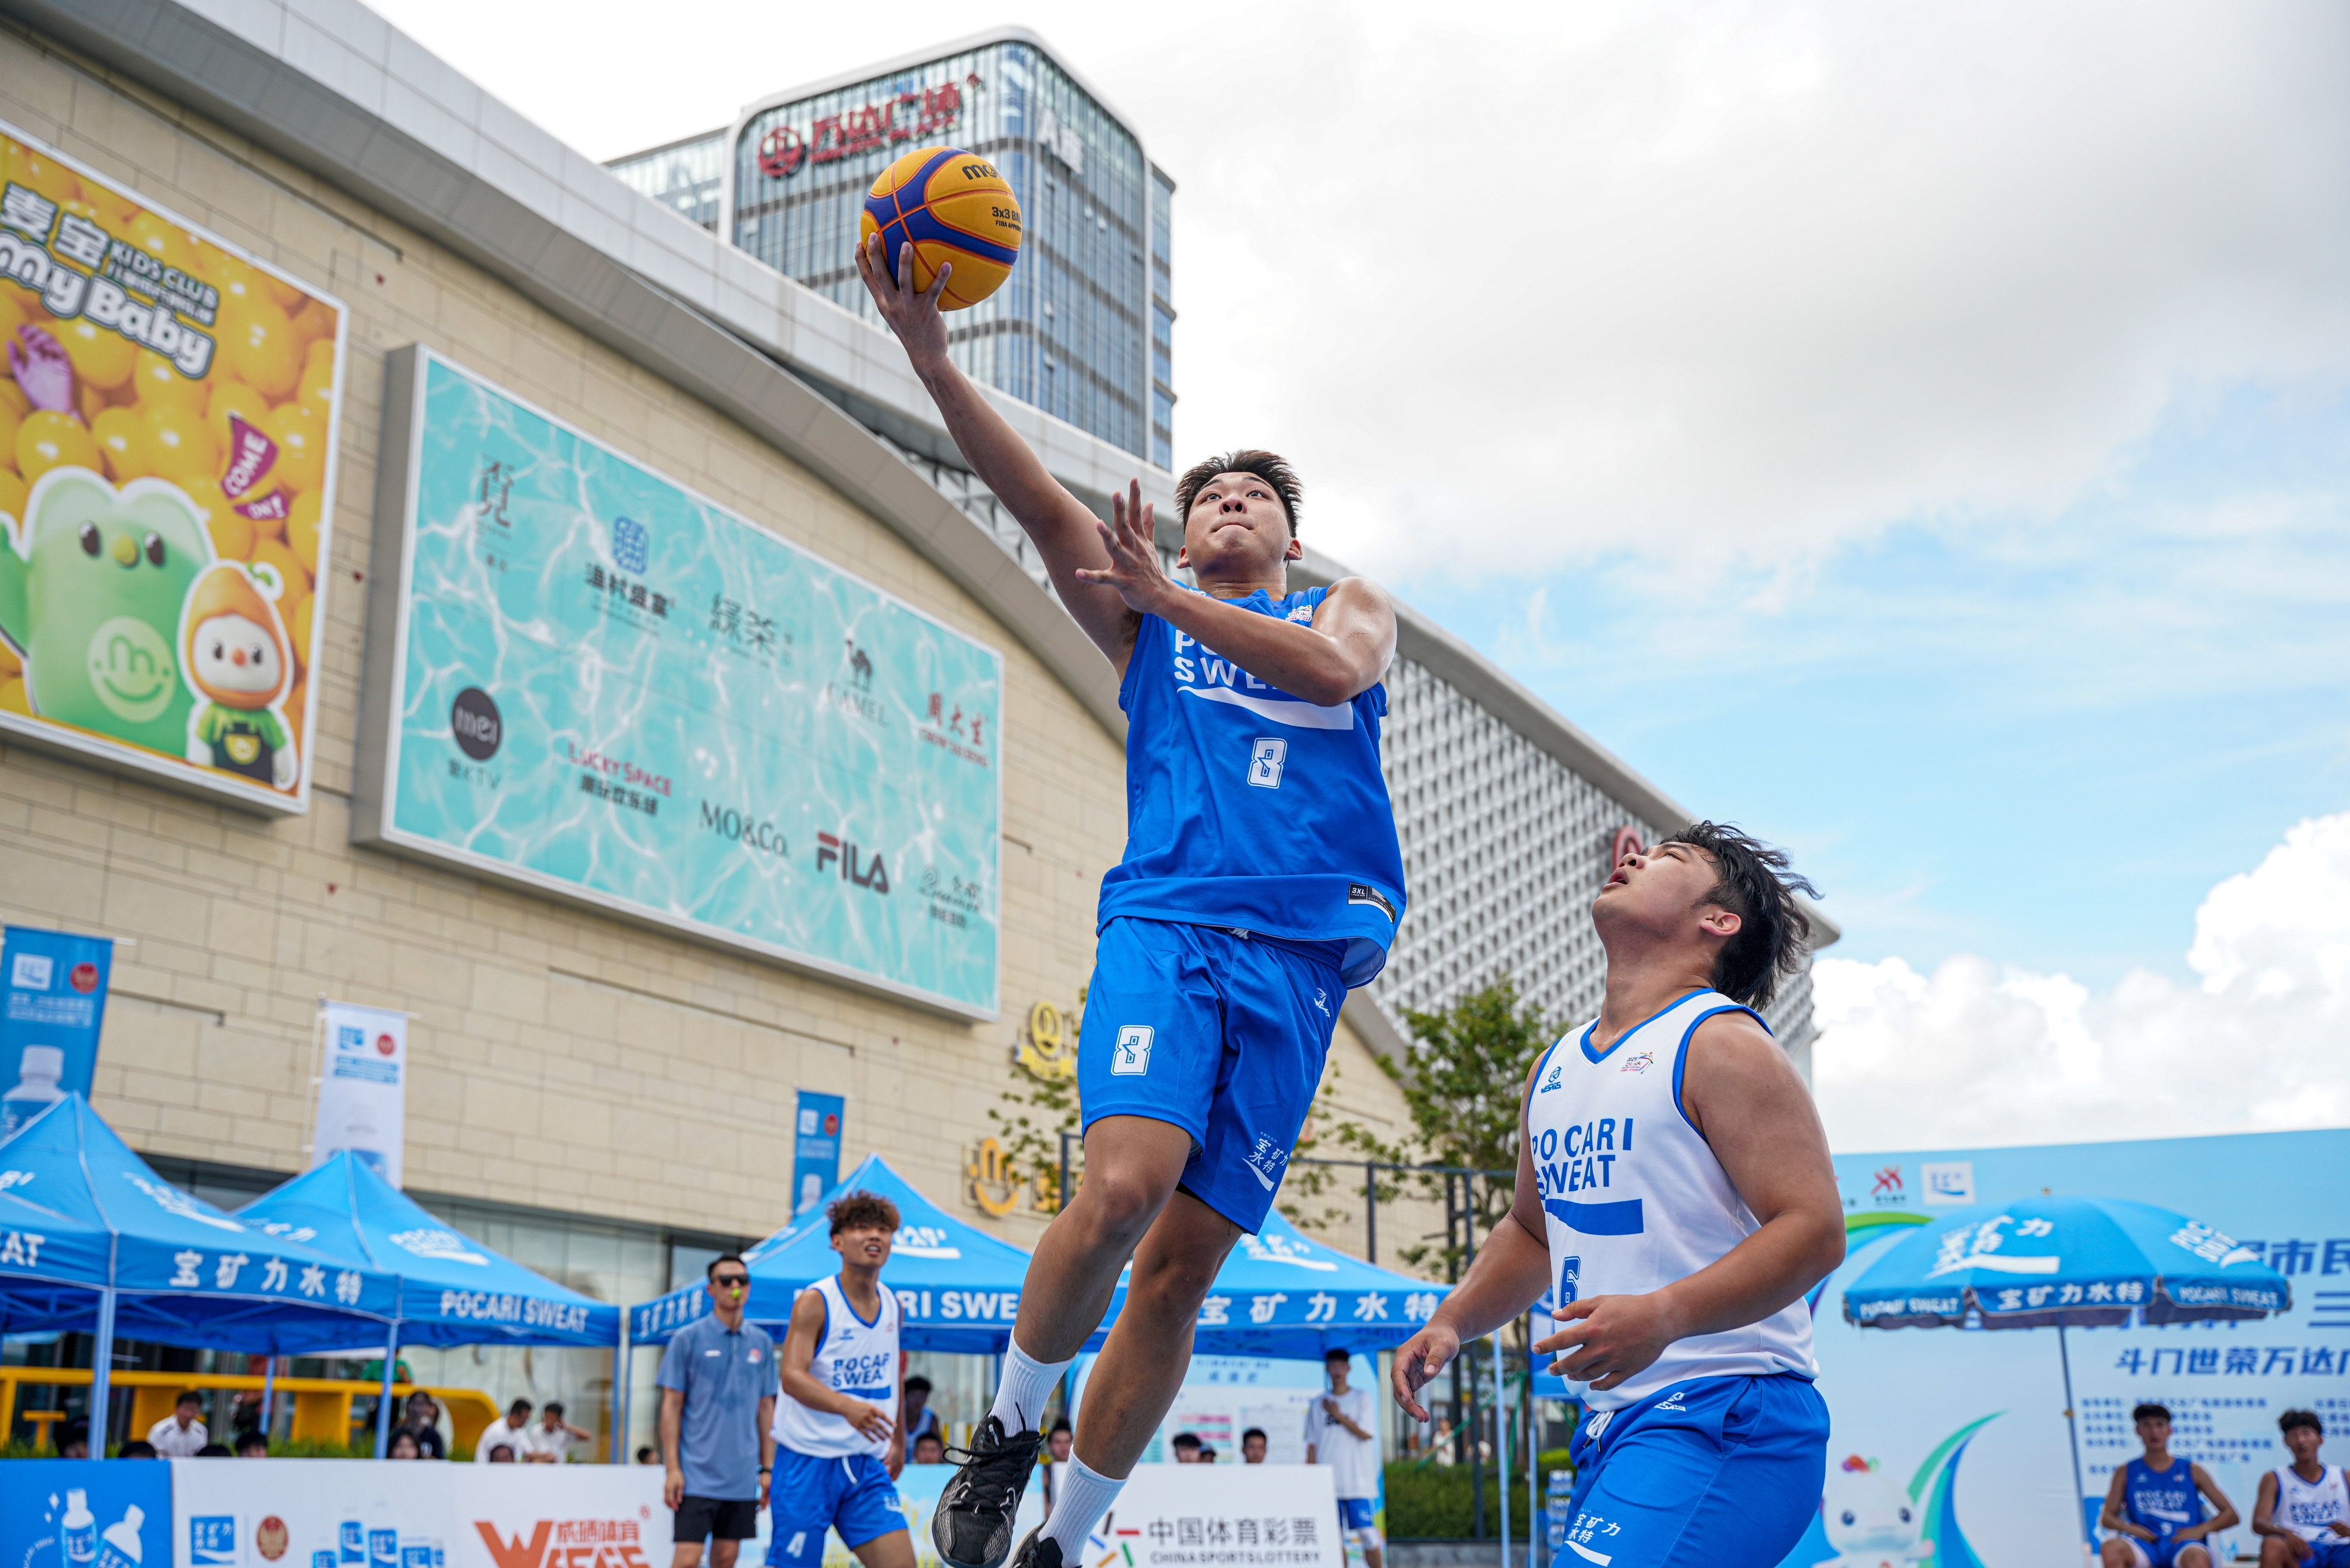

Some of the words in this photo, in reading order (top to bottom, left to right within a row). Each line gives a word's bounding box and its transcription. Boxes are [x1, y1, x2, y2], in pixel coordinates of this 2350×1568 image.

[992, 206, 1010, 219] 3x3
[111, 239, 163, 281] KIDS
[163, 267, 218, 310] CLUB
[81, 273, 215, 378] Baby
[224, 431, 269, 495] COME
[1247, 738, 1287, 789] 8
[817, 832, 889, 894] FILA
[1111, 1025, 1154, 1076] 8
[1248, 1151, 1275, 1173] 水特
[1255, 1138, 1288, 1166] 宝矿力
[169, 1250, 362, 1305] 宝矿力水特
[1559, 1256, 1580, 1309] 6
[441, 1290, 521, 1323] POCARI
[523, 1297, 590, 1333] SWEAT
[1197, 1291, 1439, 1325] 宝矿力水特
[832, 1368, 883, 1387] SWEA
[1148, 1516, 1319, 1547] 中国体育彩票
[1568, 1527, 1594, 1543] 水特
[1574, 1513, 1621, 1536] 宝矿力
[785, 1531, 807, 1559] 4
